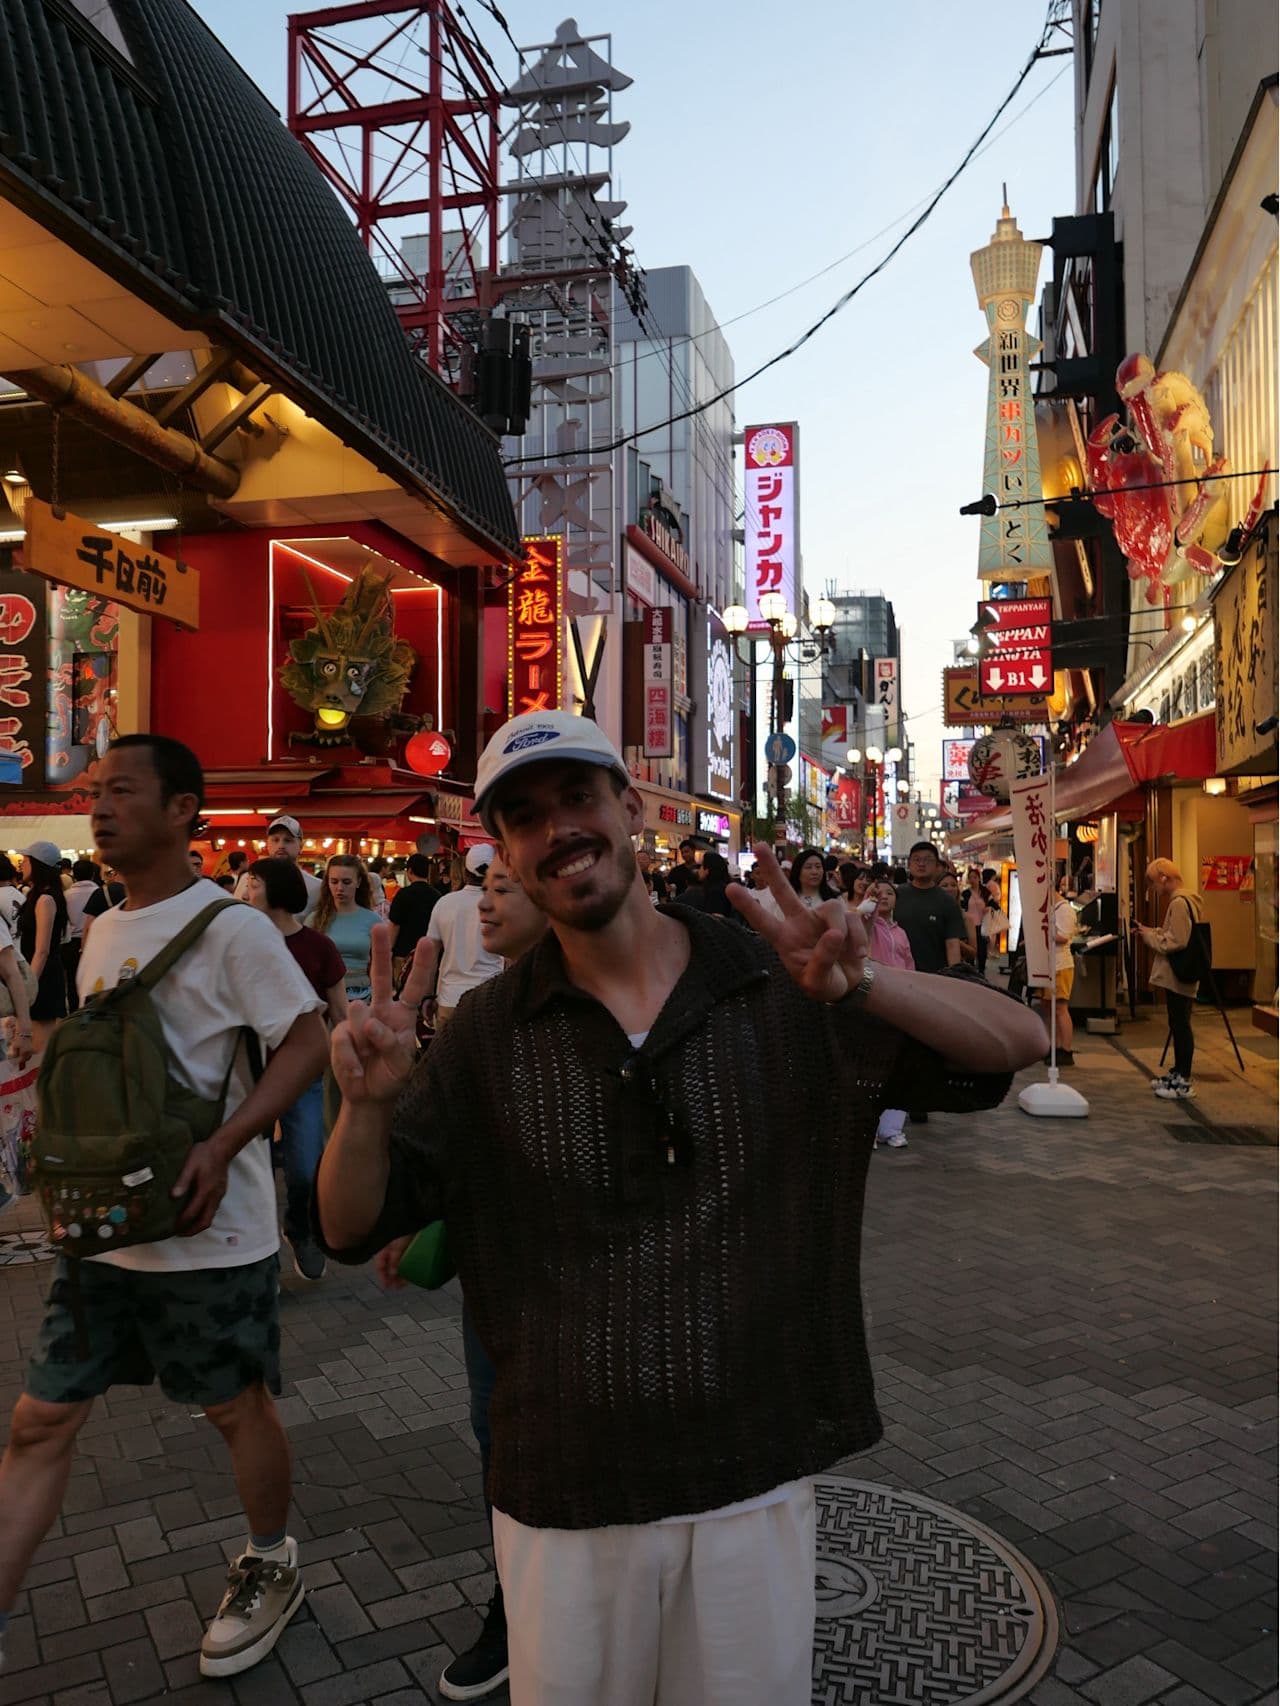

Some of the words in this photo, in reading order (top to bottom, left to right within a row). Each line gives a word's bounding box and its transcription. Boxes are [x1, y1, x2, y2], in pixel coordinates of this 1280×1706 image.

[76, 535, 166, 605] 千日前
[998, 603, 1047, 613] TEPPANYAKI
[996, 626, 1048, 642] EPPAN
[1007, 672, 1026, 686] B1
[511, 732, 550, 752] Ford
